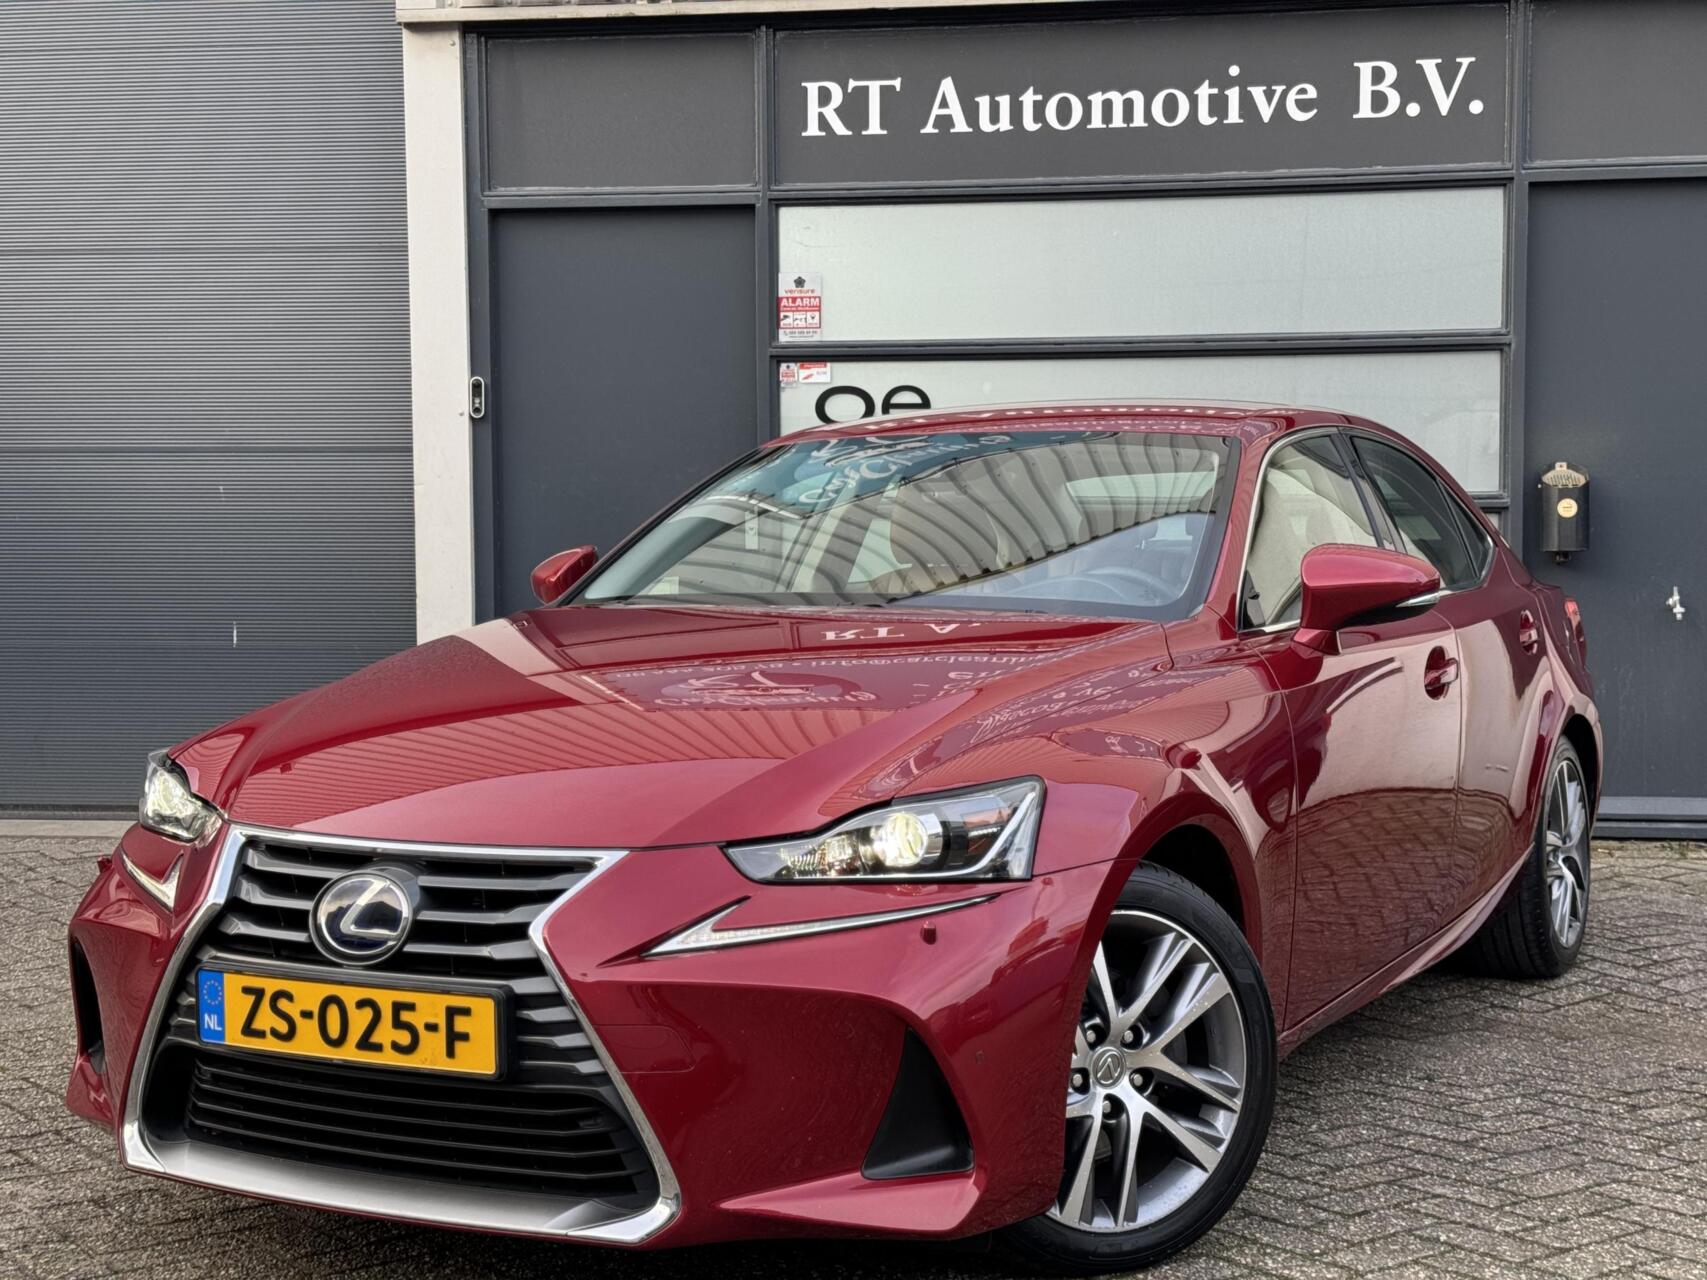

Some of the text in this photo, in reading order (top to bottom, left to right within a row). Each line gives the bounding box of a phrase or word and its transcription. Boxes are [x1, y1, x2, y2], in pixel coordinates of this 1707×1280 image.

[800, 56, 1486, 137] RT Automotive B.V.
[780, 297, 820, 307] ALARM
[203, 985, 473, 1059] NL ZS-025-F
